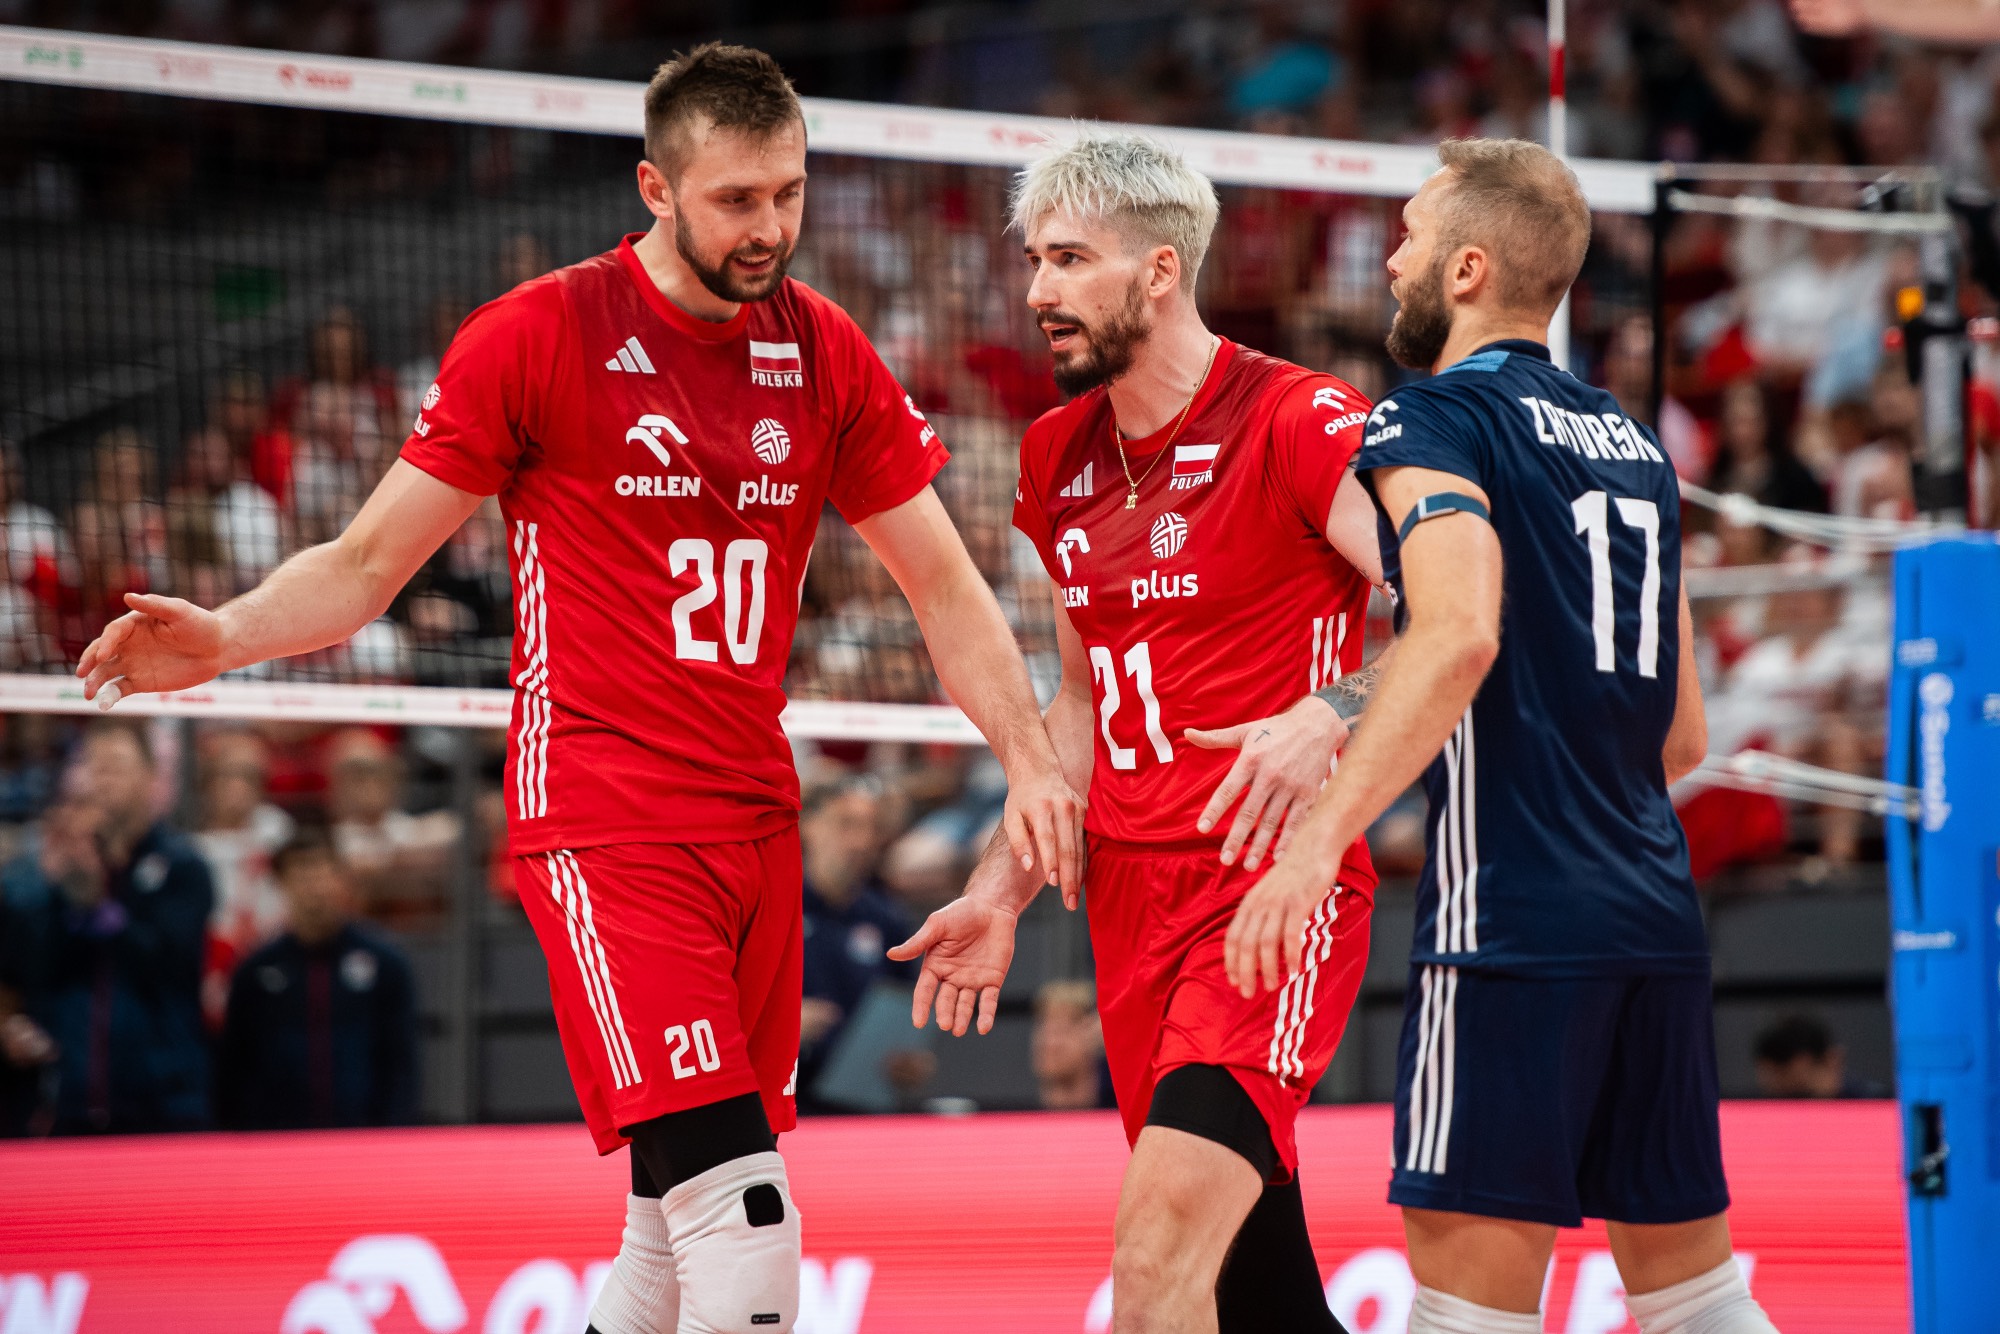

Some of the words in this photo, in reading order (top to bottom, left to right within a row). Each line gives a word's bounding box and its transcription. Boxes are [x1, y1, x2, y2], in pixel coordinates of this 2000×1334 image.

[752, 371, 803, 387] POLSKA
[414, 412, 431, 437] lus
[1324, 412, 1368, 435] ORLEN
[1365, 423, 1402, 446] RLEN
[614, 475, 701, 497] ORLEN
[737, 475, 799, 511] plus
[1061, 585, 1089, 608] LEN
[1131, 570, 1199, 608] plus
[1571, 490, 1660, 678] 17
[668, 538, 769, 665] 20
[1089, 641, 1174, 770] 21
[664, 1018, 721, 1080] 20
